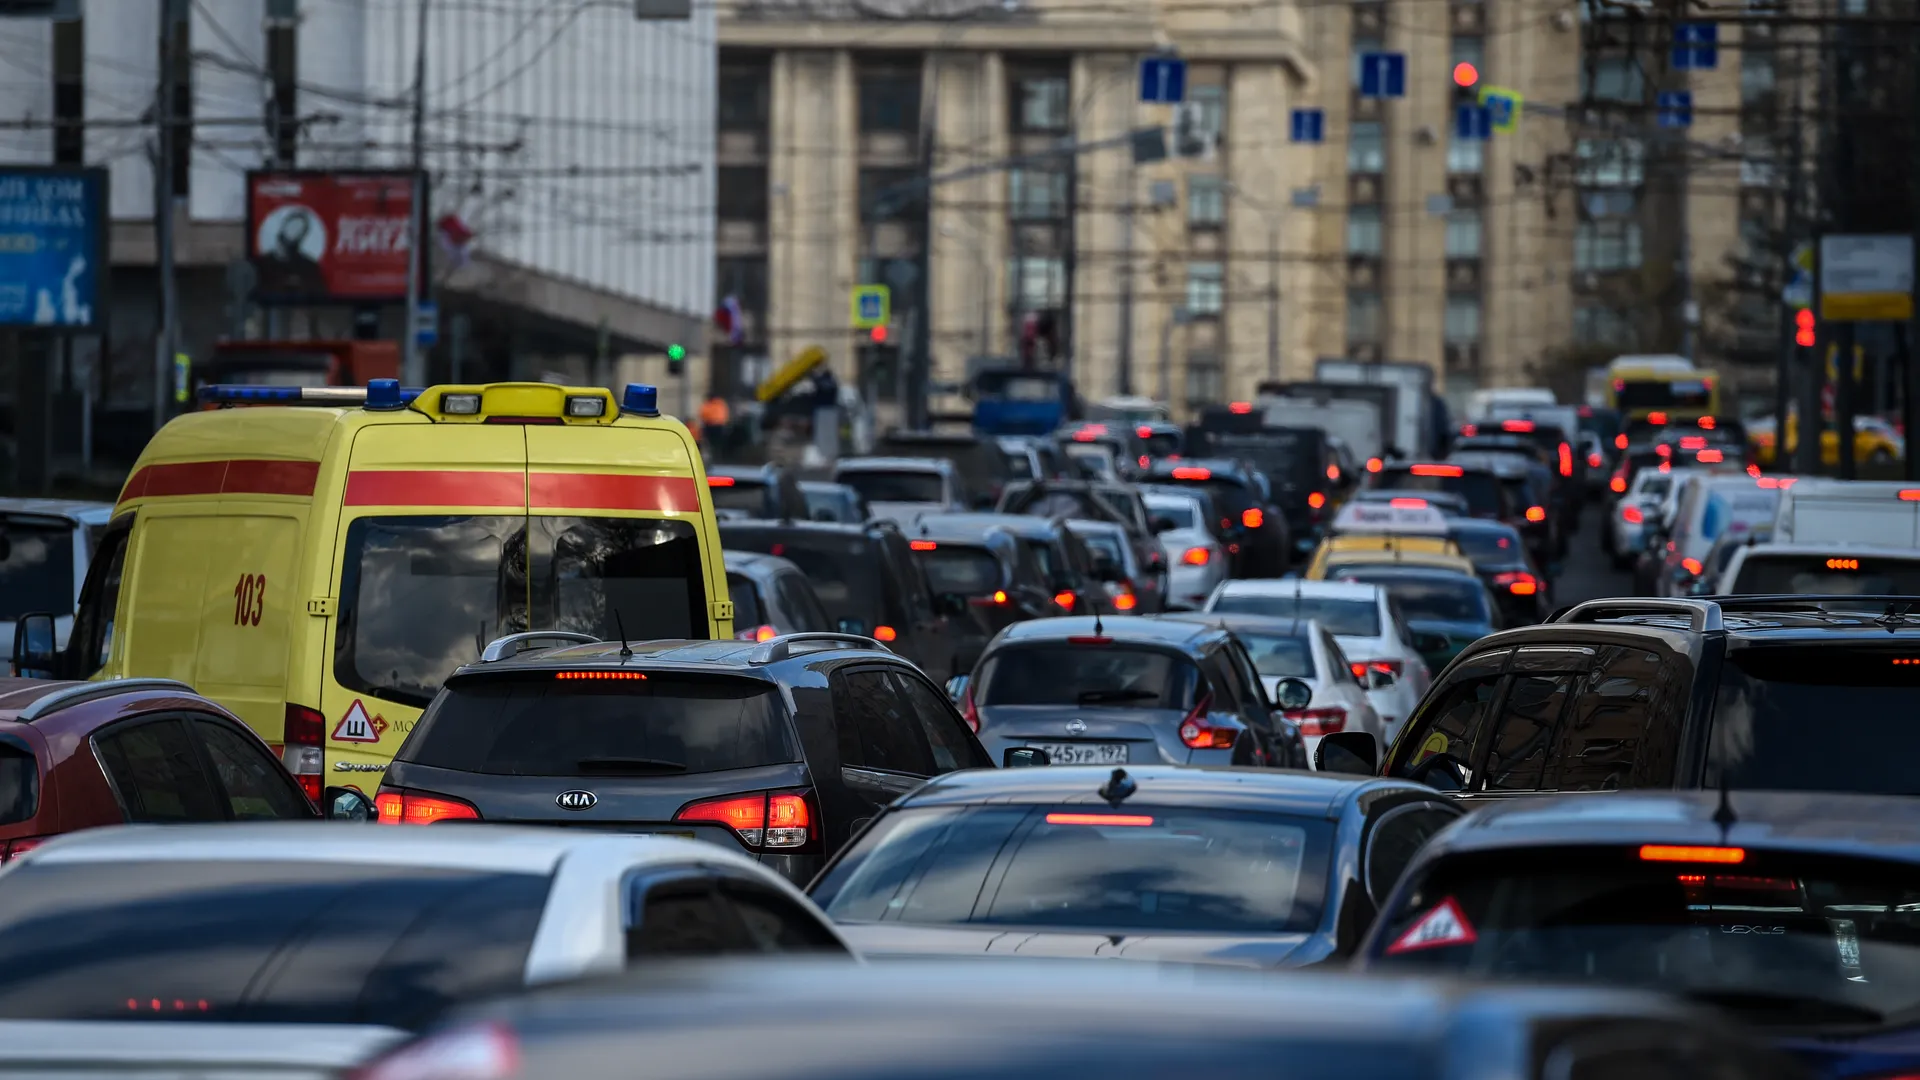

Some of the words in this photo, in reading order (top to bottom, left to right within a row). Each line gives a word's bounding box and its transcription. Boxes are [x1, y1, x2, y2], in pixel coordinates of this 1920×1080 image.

[234, 573, 266, 627] 103
[346, 720, 366, 737] Ш
[562, 794, 590, 806] KIA
[1720, 924, 1785, 935] LEXUS
